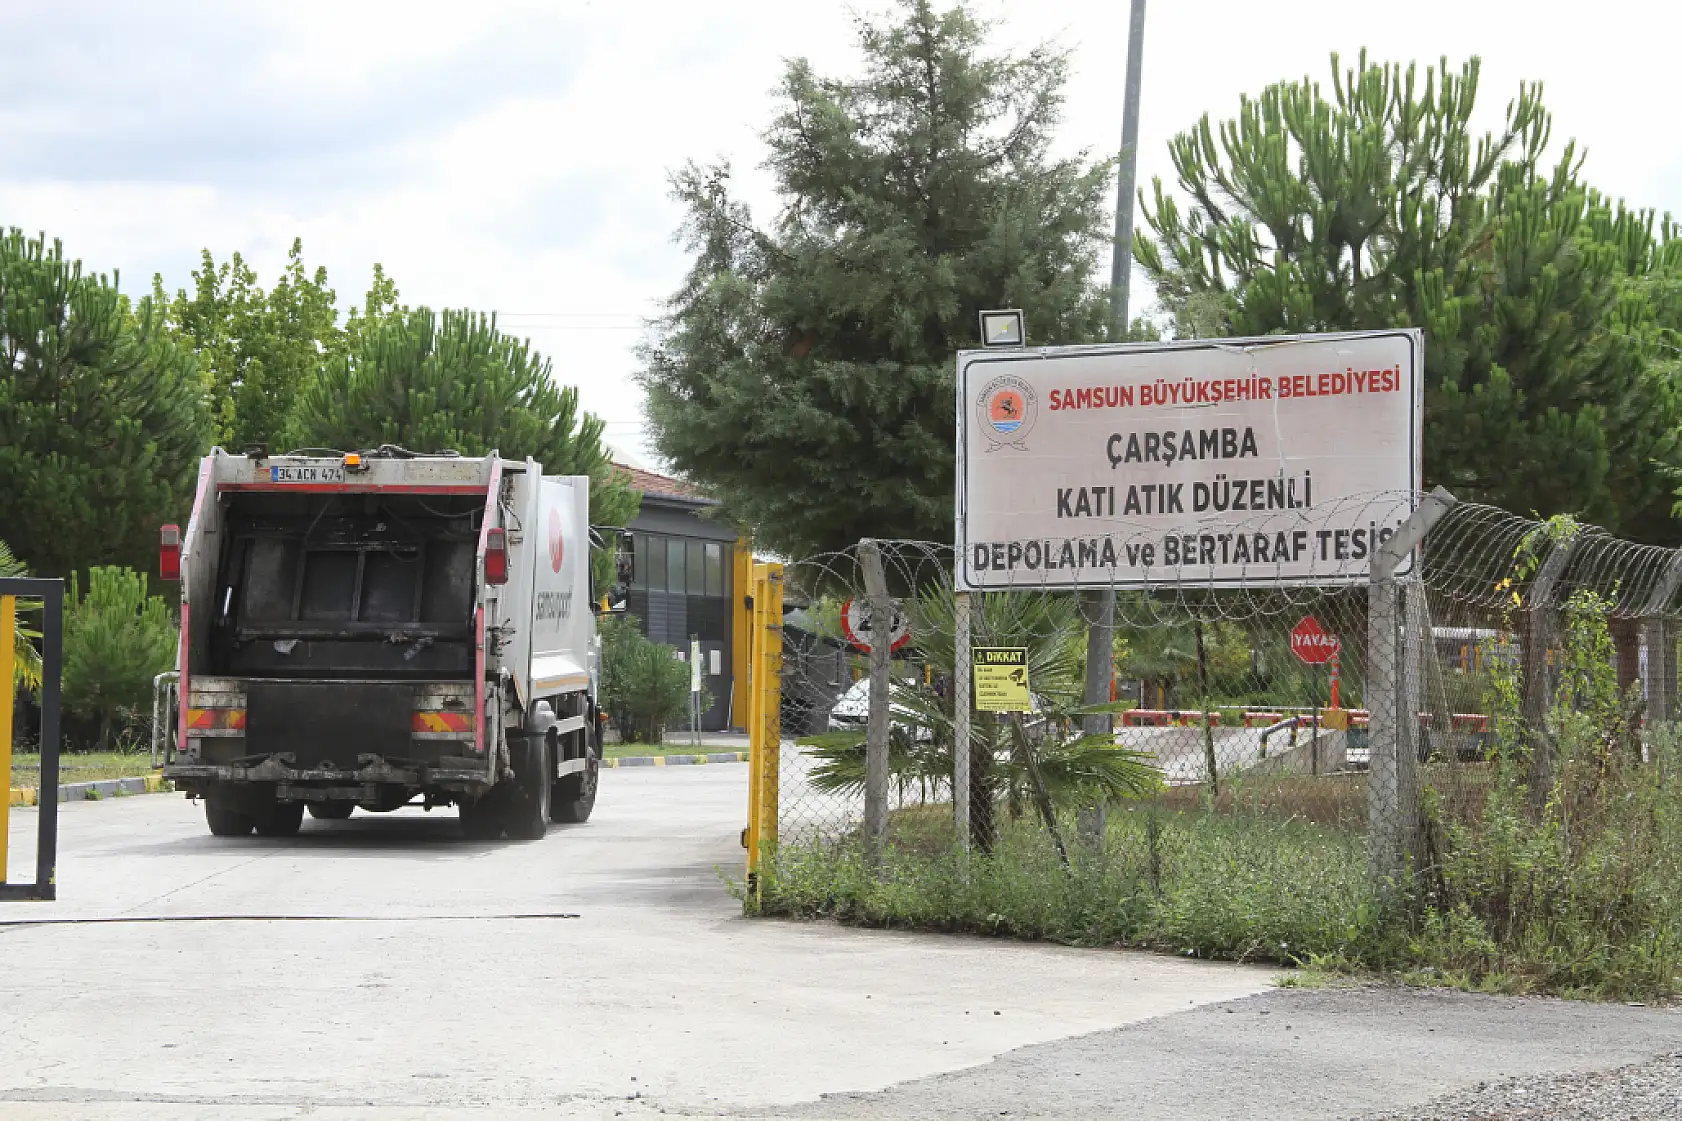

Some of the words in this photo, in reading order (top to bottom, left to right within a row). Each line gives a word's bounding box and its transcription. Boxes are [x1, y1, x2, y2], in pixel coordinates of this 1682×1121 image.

[1049, 385, 1134, 410] SAMSUN
[1140, 374, 1272, 407] BÜYÜKŞEHİR
[1278, 364, 1400, 398] BELEDİYESİ
[1106, 427, 1258, 469] ÇARŞAMBA
[279, 468, 292, 480] 34
[321, 468, 341, 480] 474
[1057, 486, 1115, 518] KATI
[1123, 483, 1184, 515] ATIK
[1192, 469, 1311, 512] DÜZENLİ
[973, 537, 1117, 571] DEPOLAMA
[1125, 543, 1155, 566] ve
[1164, 530, 1307, 565] BERTARAF
